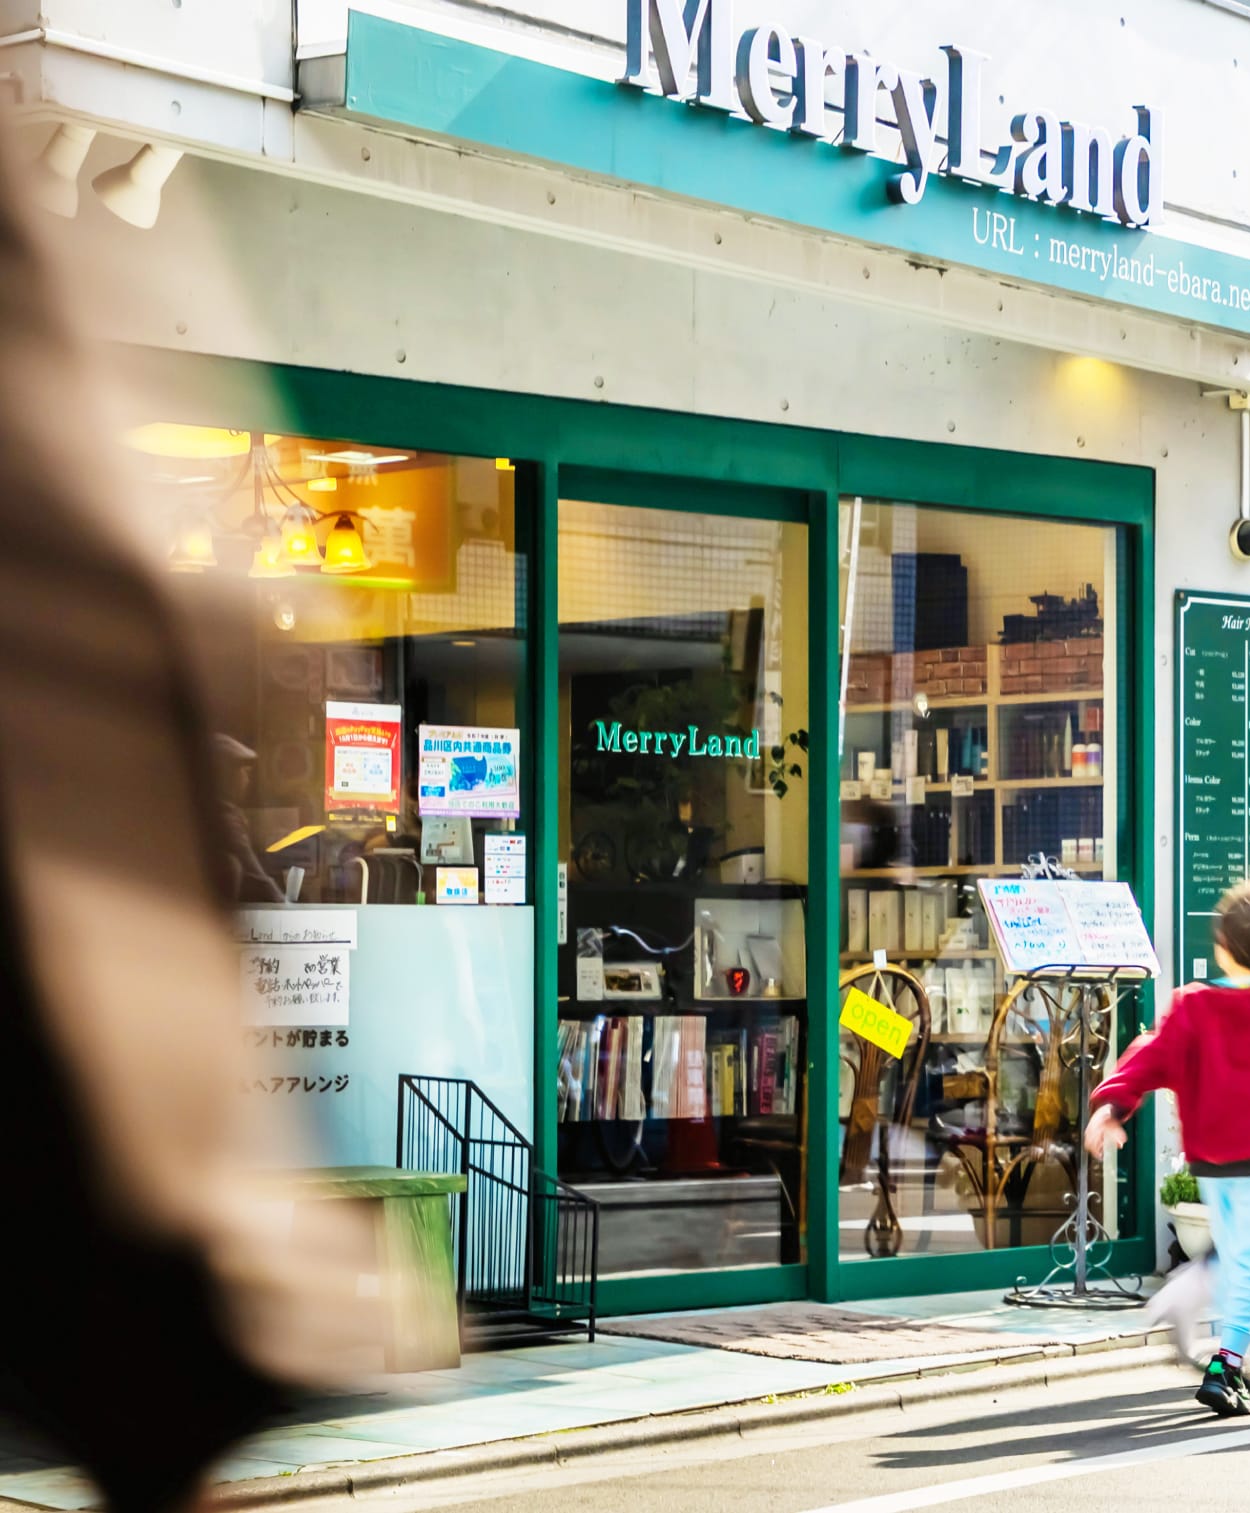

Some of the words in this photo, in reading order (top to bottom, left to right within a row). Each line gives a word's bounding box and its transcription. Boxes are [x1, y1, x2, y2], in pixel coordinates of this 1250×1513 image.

[618, 0, 1165, 228] MerryLand
[972, 205, 1024, 257] URL
[1221, 615, 1244, 630] Hair
[423, 738, 512, 755] 品川区内共通商品券
[595, 719, 761, 760] MerryLand
[850, 1003, 902, 1046] open
[241, 1074, 350, 1095] ヘアアレンジ
